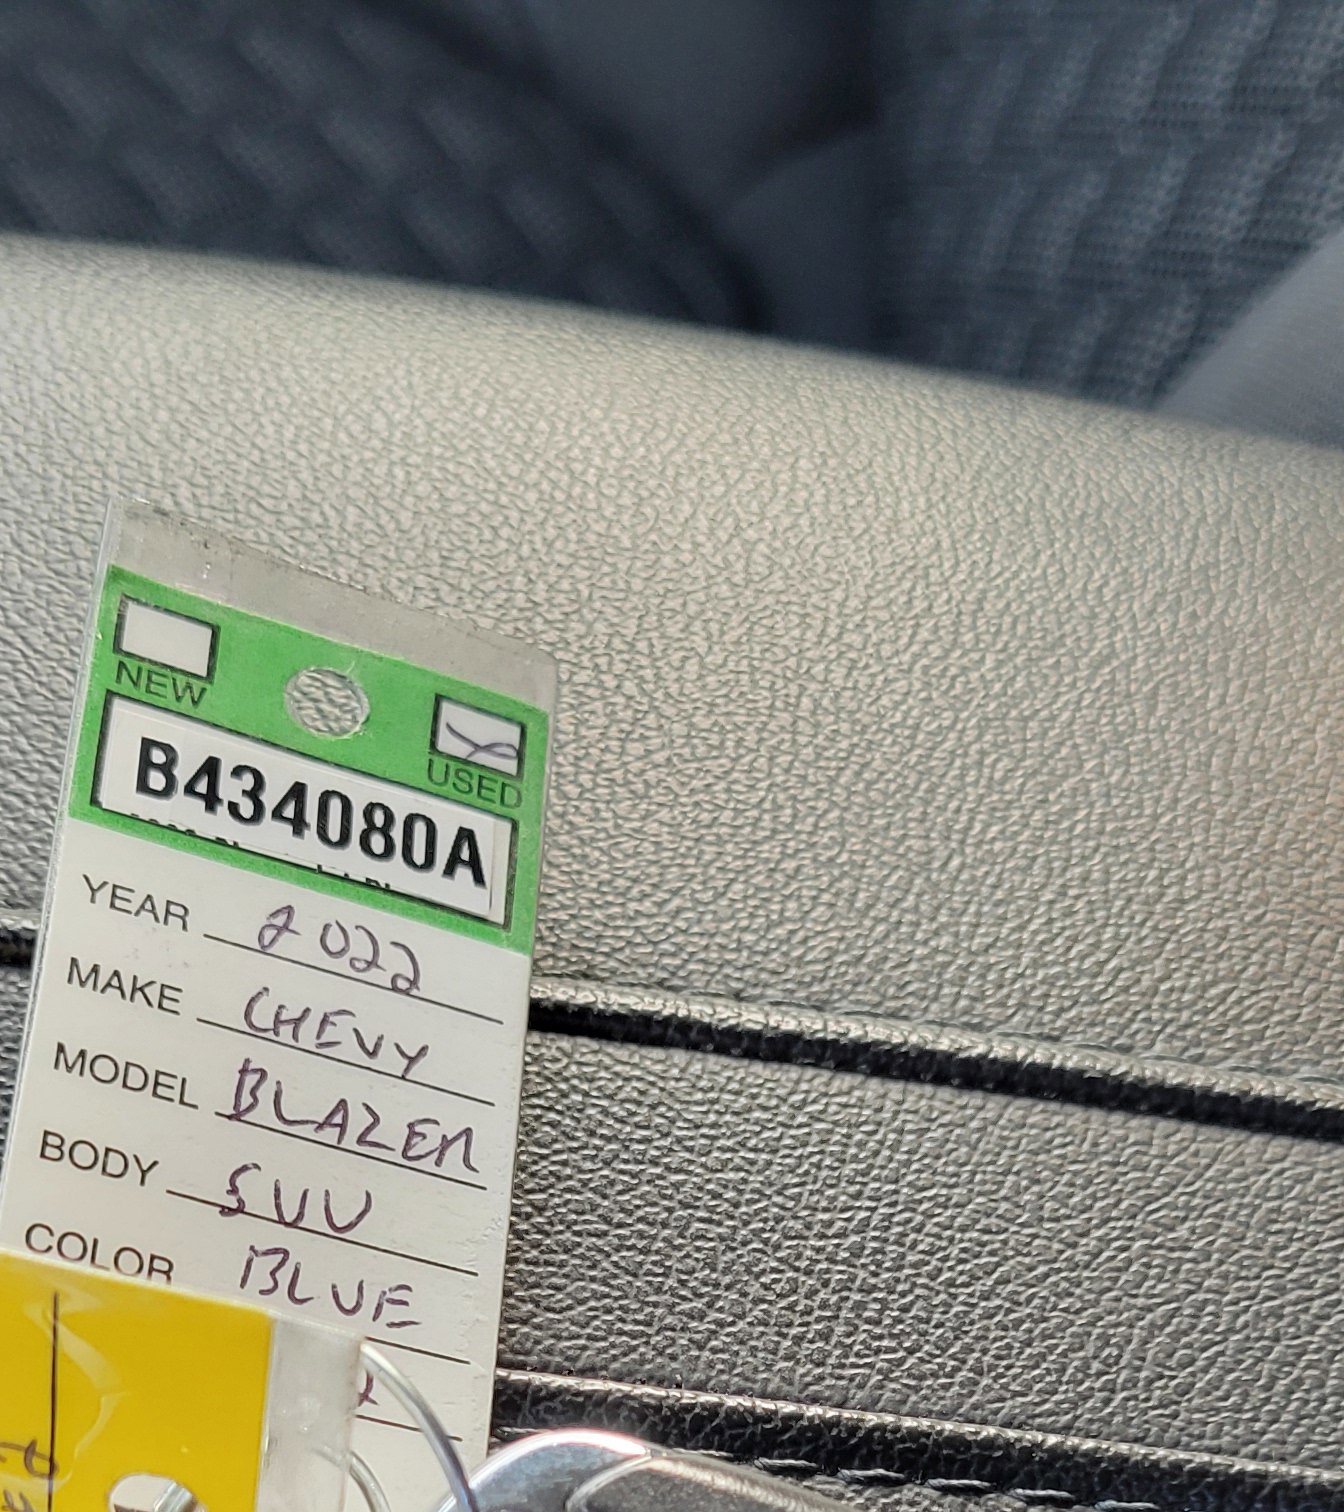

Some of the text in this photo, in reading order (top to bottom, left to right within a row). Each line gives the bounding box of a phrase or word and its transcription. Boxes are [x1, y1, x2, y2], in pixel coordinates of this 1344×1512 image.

[115, 661, 208, 708] NEW
[134, 736, 487, 888] B434080A
[426, 758, 523, 811] USED
[82, 874, 422, 994] YEAR 2022
[67, 956, 429, 1080] MAKE CHEVY
[54, 1042, 199, 1110] MODEL
[39, 1129, 159, 1188] BODY
[24, 1223, 422, 1329] COLOR BLUE
